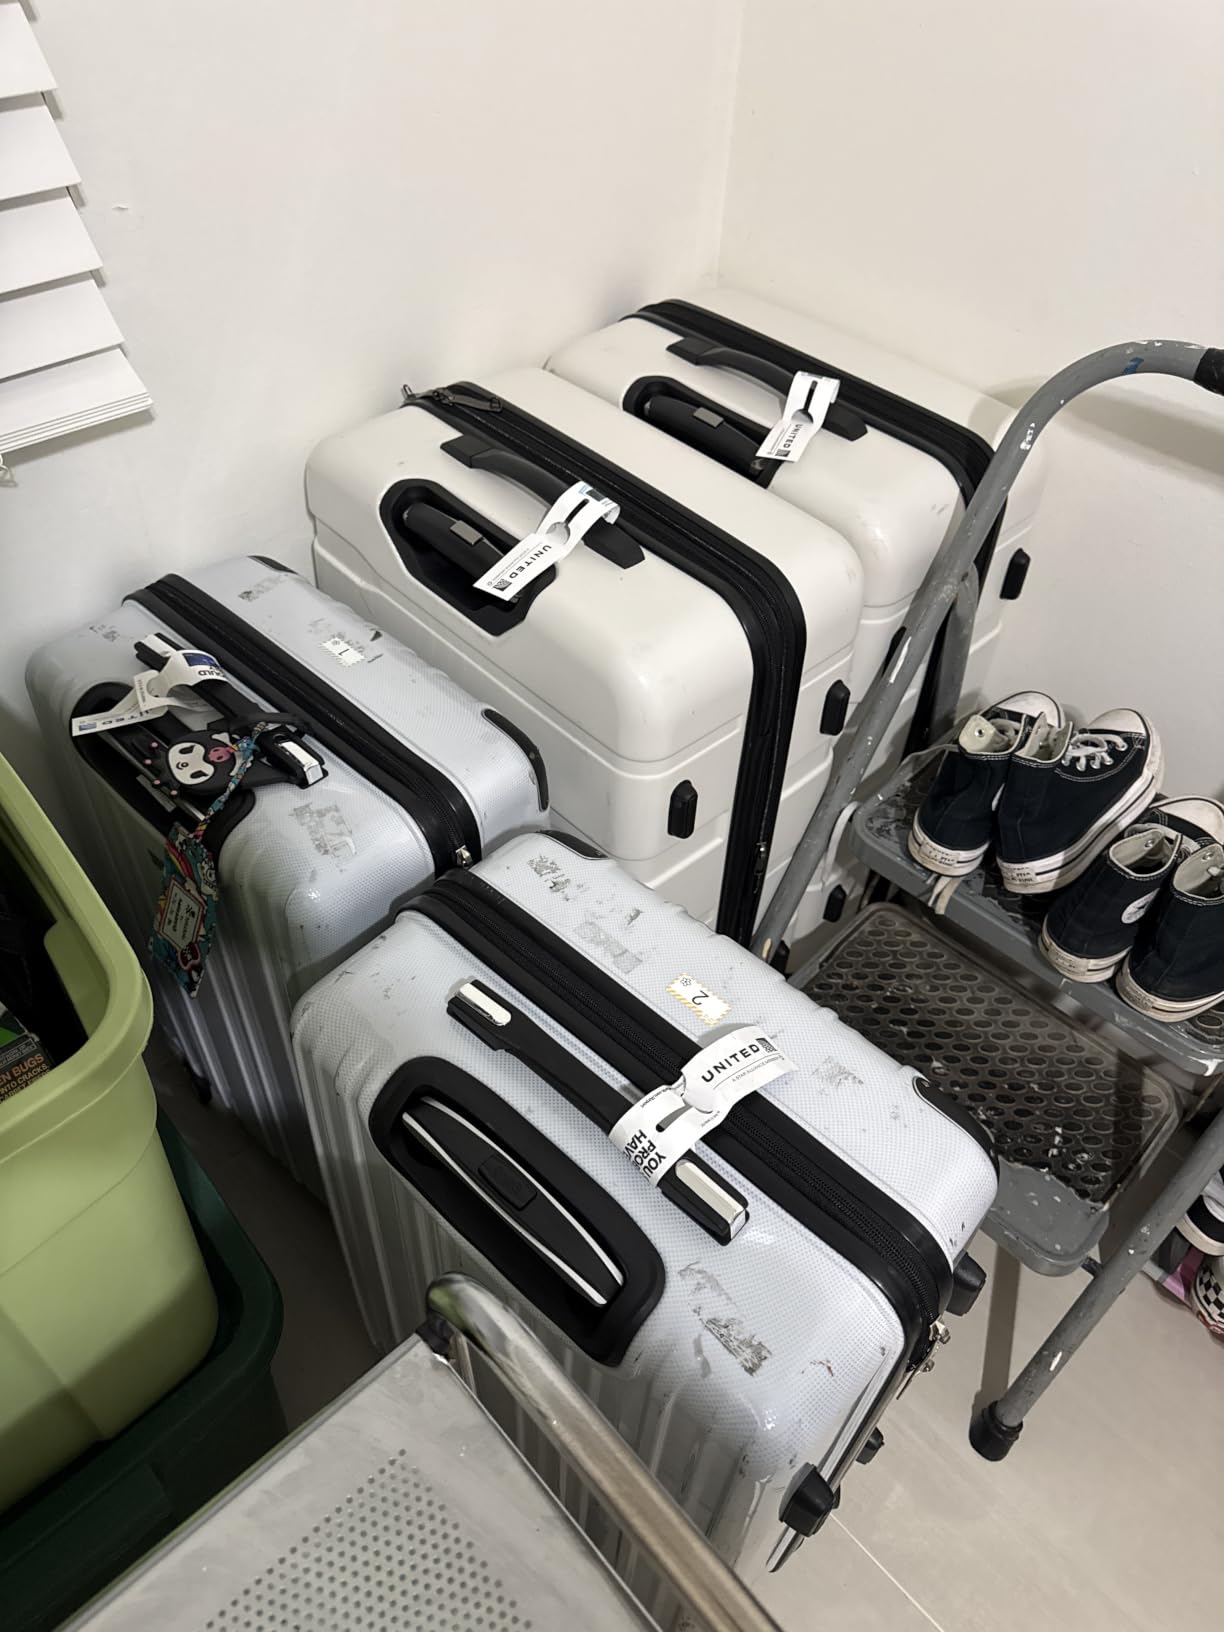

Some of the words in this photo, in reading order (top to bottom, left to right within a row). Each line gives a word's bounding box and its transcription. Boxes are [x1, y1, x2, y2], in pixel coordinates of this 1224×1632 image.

[783, 424, 803, 448] UNITED
[509, 544, 552, 579] UNITED
[691, 989, 709, 1006] 2
[12, 1053, 44, 1077] BUGS
[701, 1043, 760, 1083] UNITED
[643, 1151, 667, 1178] YOU
